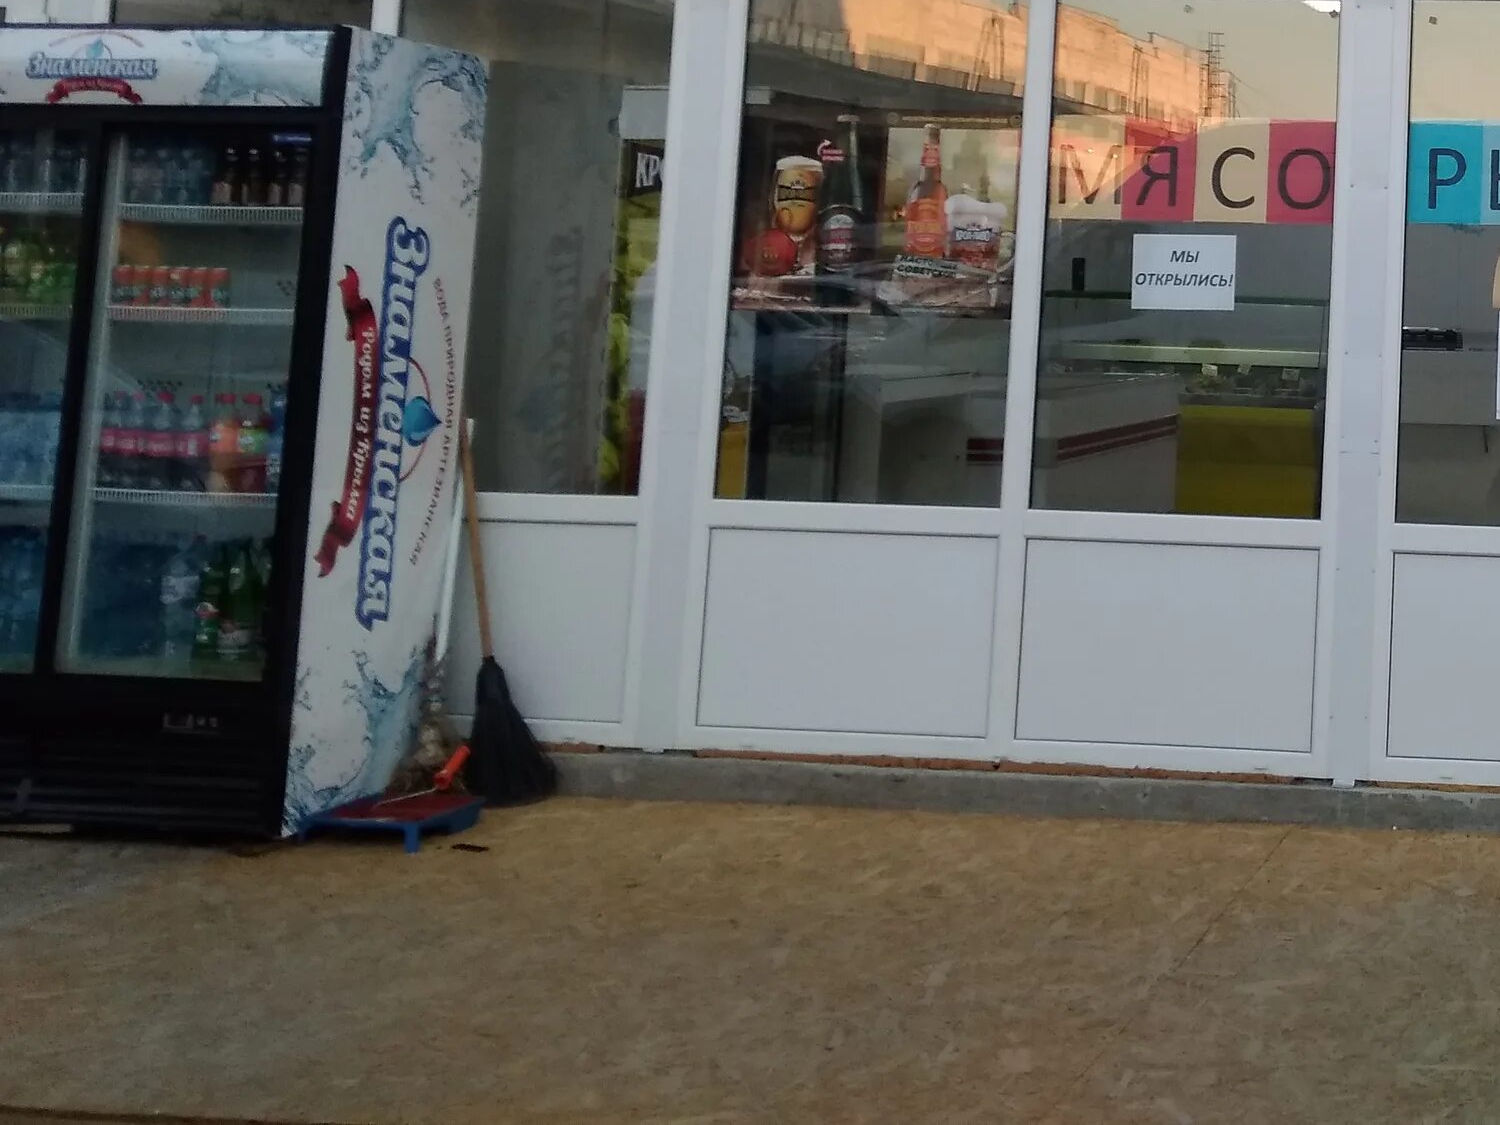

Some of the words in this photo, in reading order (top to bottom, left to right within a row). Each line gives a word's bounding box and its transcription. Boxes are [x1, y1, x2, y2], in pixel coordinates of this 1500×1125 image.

[1058, 144, 1332, 210] МЯСО
[1170, 250, 1200, 263] МЫ
[1135, 273, 1233, 287] ОТКРЫЛИСЬ!
[358, 326, 375, 398] Родом
[355, 407, 370, 434] из
[356, 217, 430, 630] Знаменская
